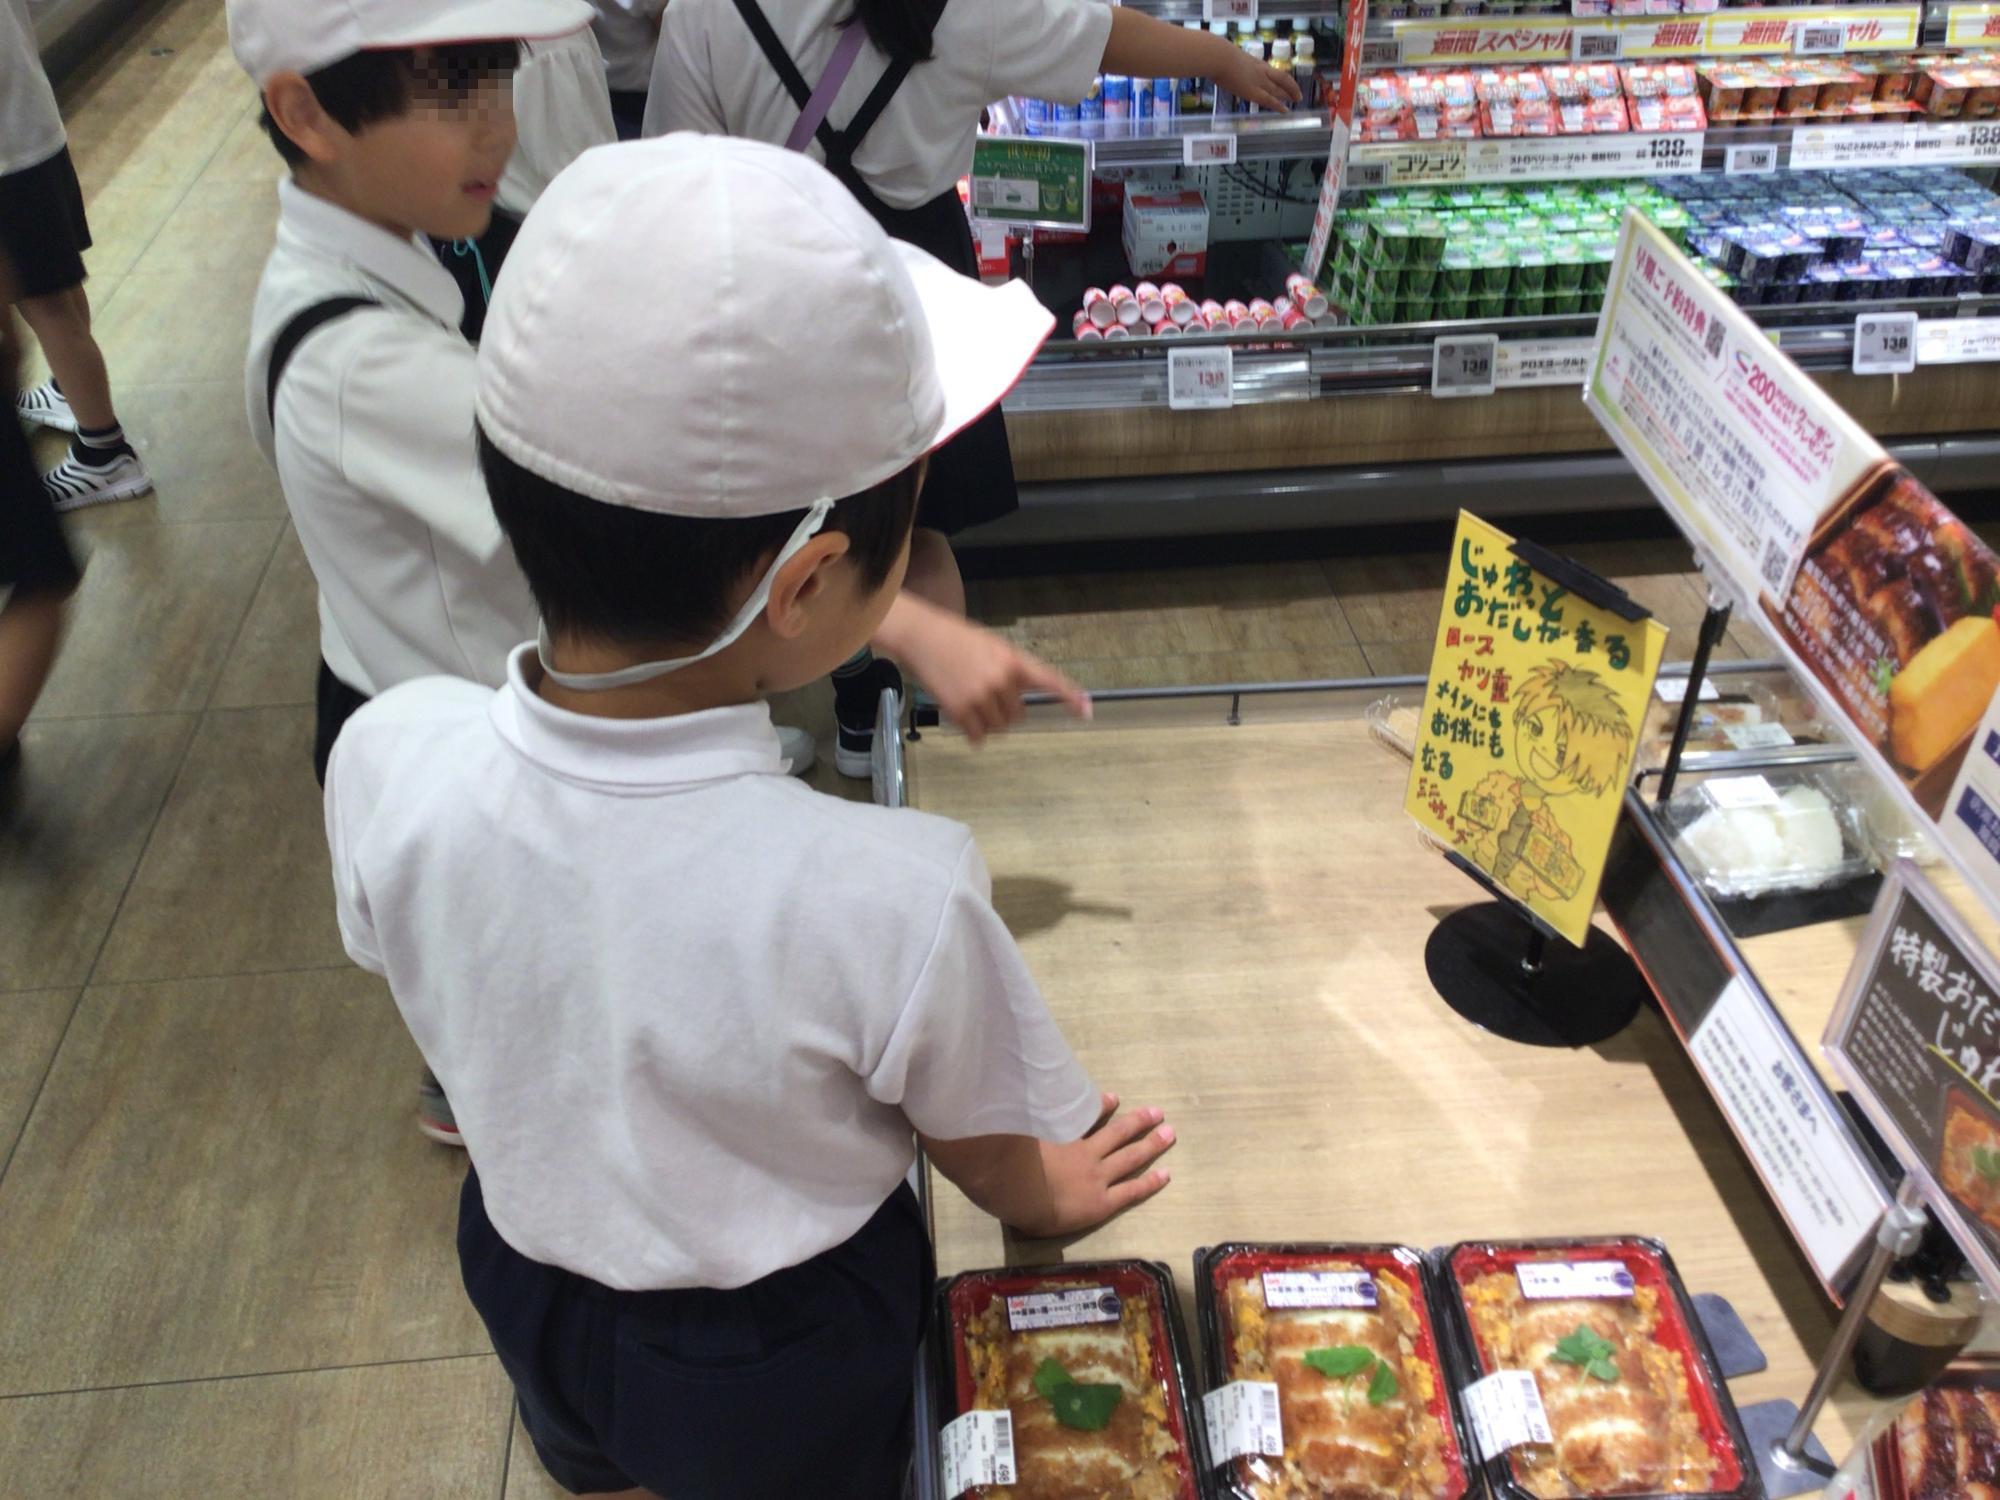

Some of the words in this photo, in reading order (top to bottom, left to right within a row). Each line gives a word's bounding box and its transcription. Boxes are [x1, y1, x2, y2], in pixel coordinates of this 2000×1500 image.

[1651, 22, 1702, 48] 週間
[1882, 337, 1908, 350] 138
[1461, 359, 1488, 374] 138
[1747, 362, 1777, 405] 200
[1460, 537, 1568, 622] じゅわっと
[1446, 626, 1494, 656] ロース
[1453, 579, 1631, 671] おだしが香る
[1458, 658, 1512, 704] カツ重
[1436, 679, 1502, 730] メインにも
[1421, 742, 1454, 780] なる
